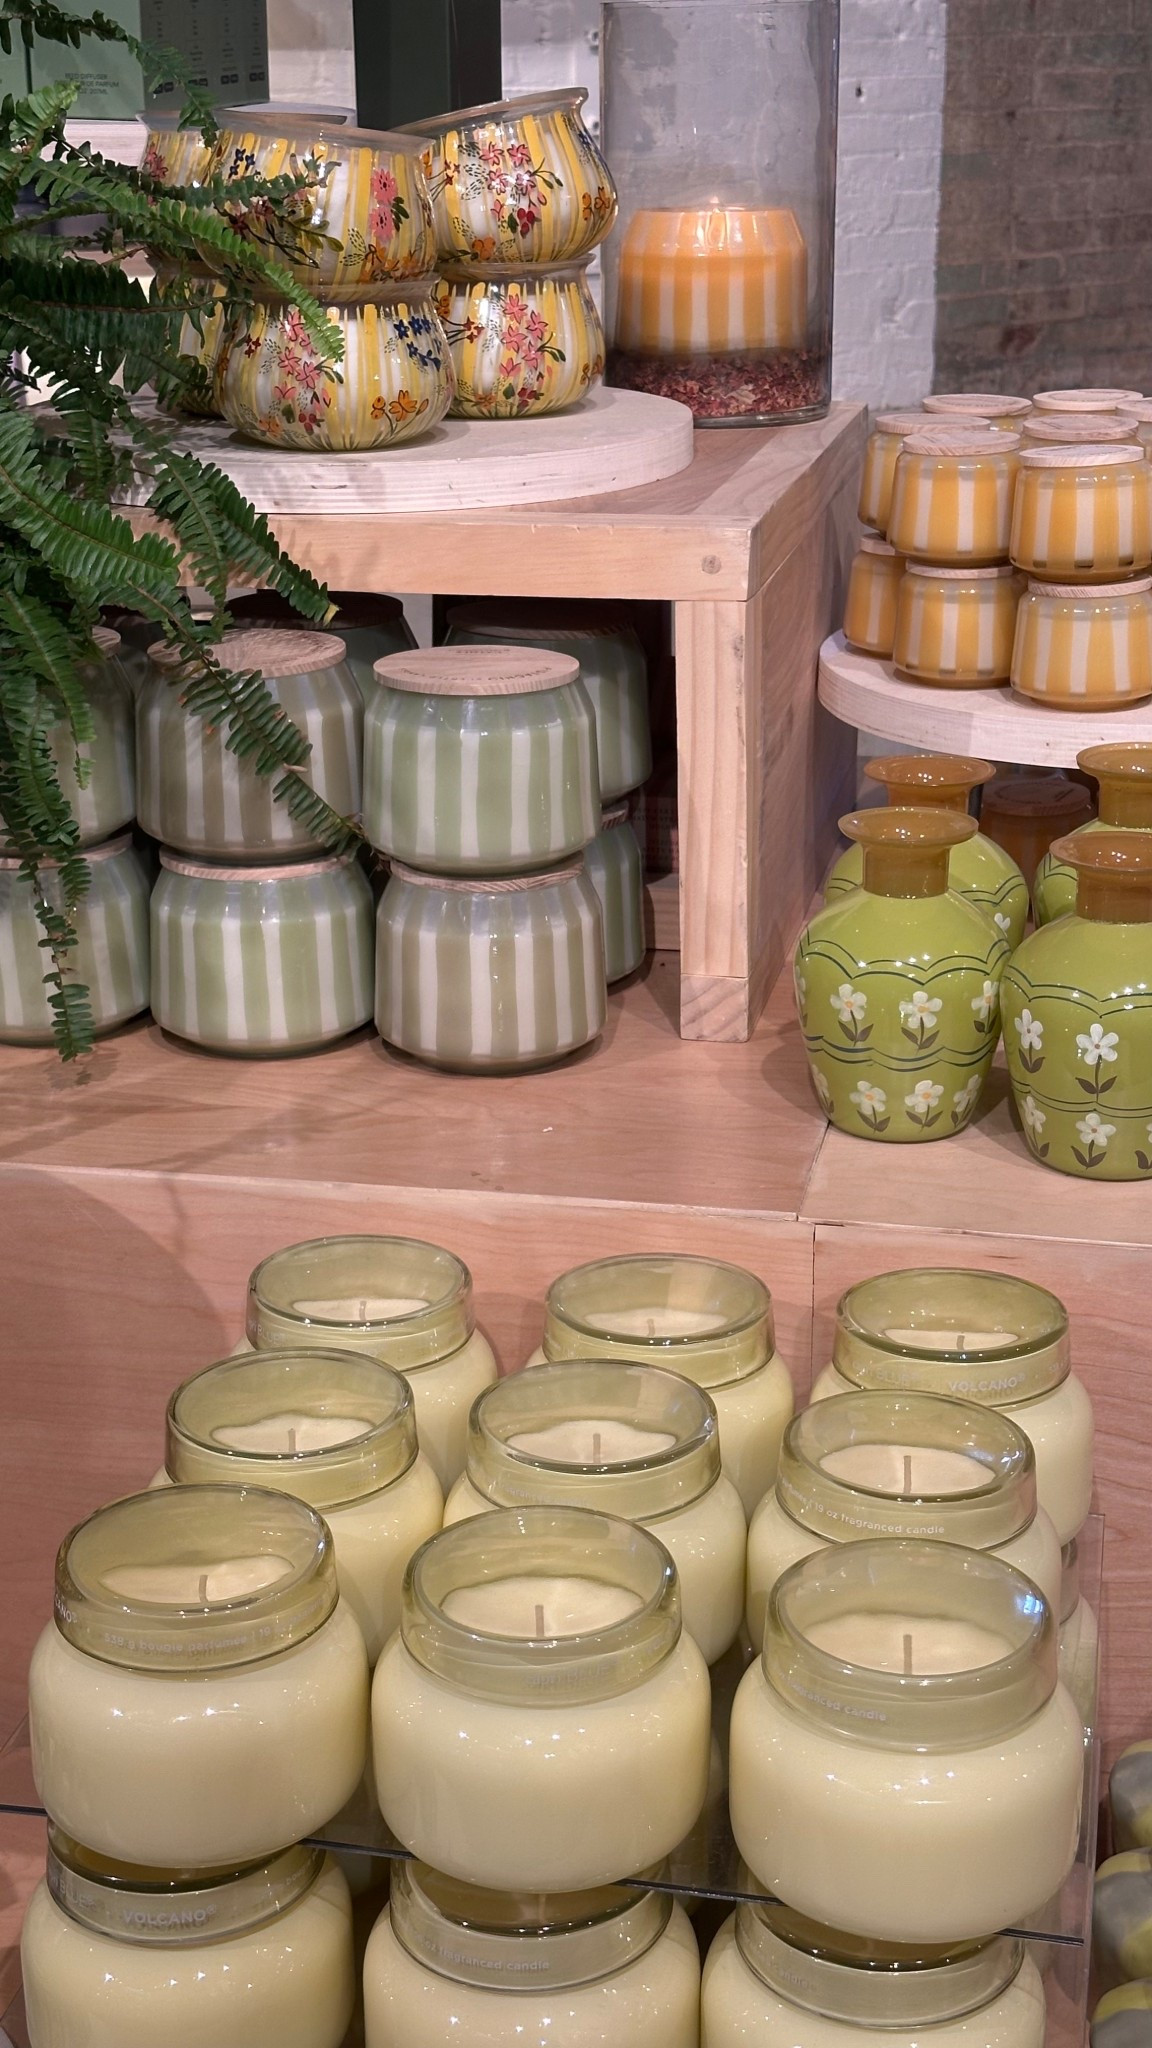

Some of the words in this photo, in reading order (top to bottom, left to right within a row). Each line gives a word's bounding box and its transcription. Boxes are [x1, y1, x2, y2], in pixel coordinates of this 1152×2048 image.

[841, 1513, 902, 1534] fragranced
[906, 1525, 945, 1535] candle
[844, 1704, 887, 1722] candle
[507, 1959, 551, 1971] candle
